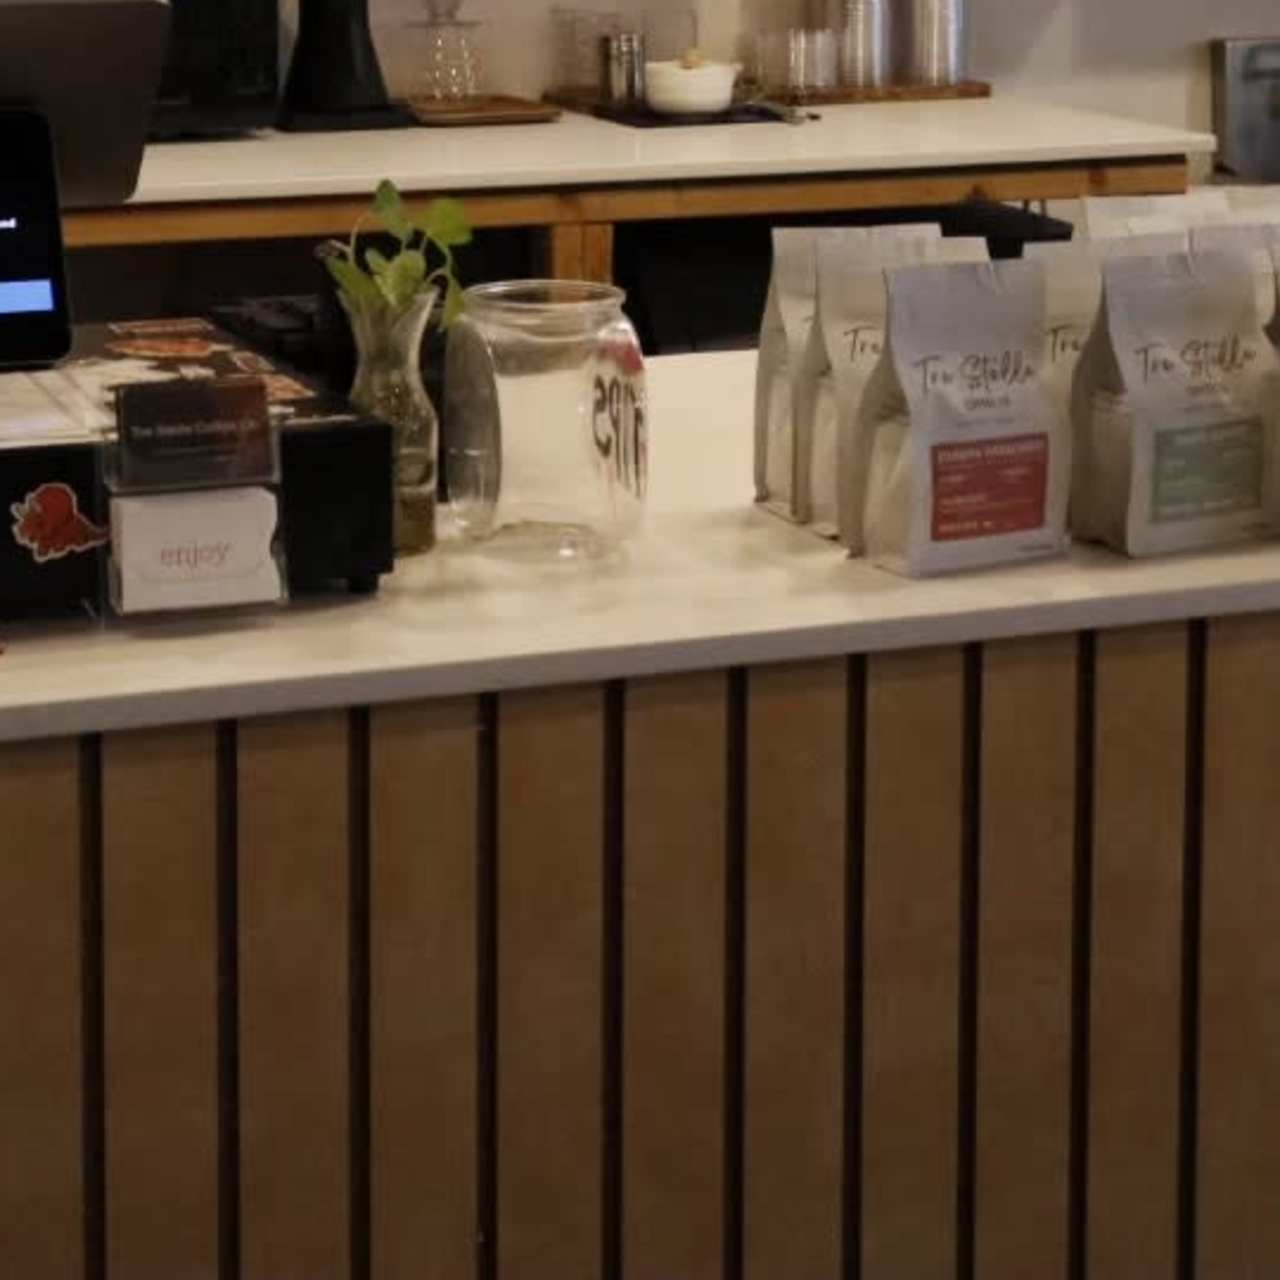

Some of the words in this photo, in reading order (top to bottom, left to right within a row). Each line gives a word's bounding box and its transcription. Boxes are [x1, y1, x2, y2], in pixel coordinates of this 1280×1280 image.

[912, 354, 955, 397] Tre
[1133, 342, 1176, 385] Tre
[160, 539, 232, 570] enjoy
